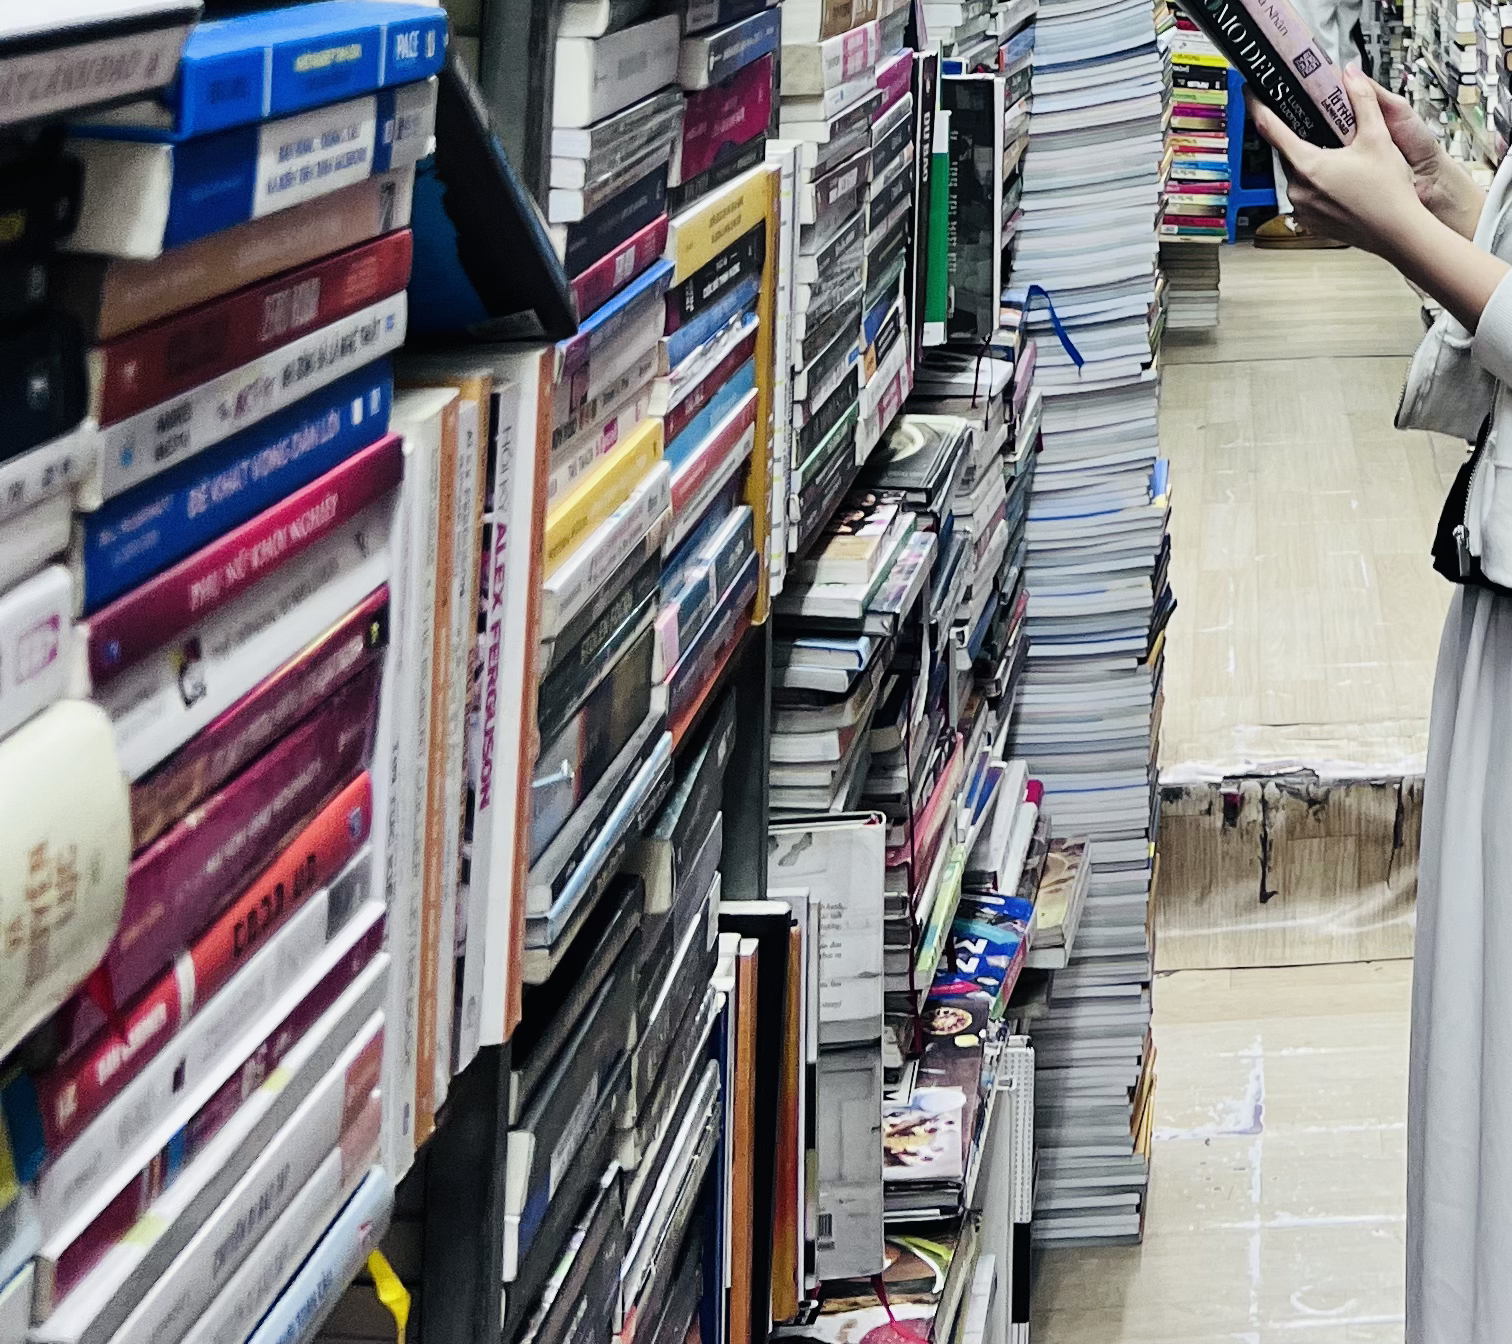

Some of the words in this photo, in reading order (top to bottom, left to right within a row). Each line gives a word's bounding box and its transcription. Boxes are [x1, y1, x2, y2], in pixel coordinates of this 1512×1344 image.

[1237, 39, 1293, 103] DEUS
[490, 521, 509, 580] ALEX
[479, 590, 506, 807] FERGUSON
